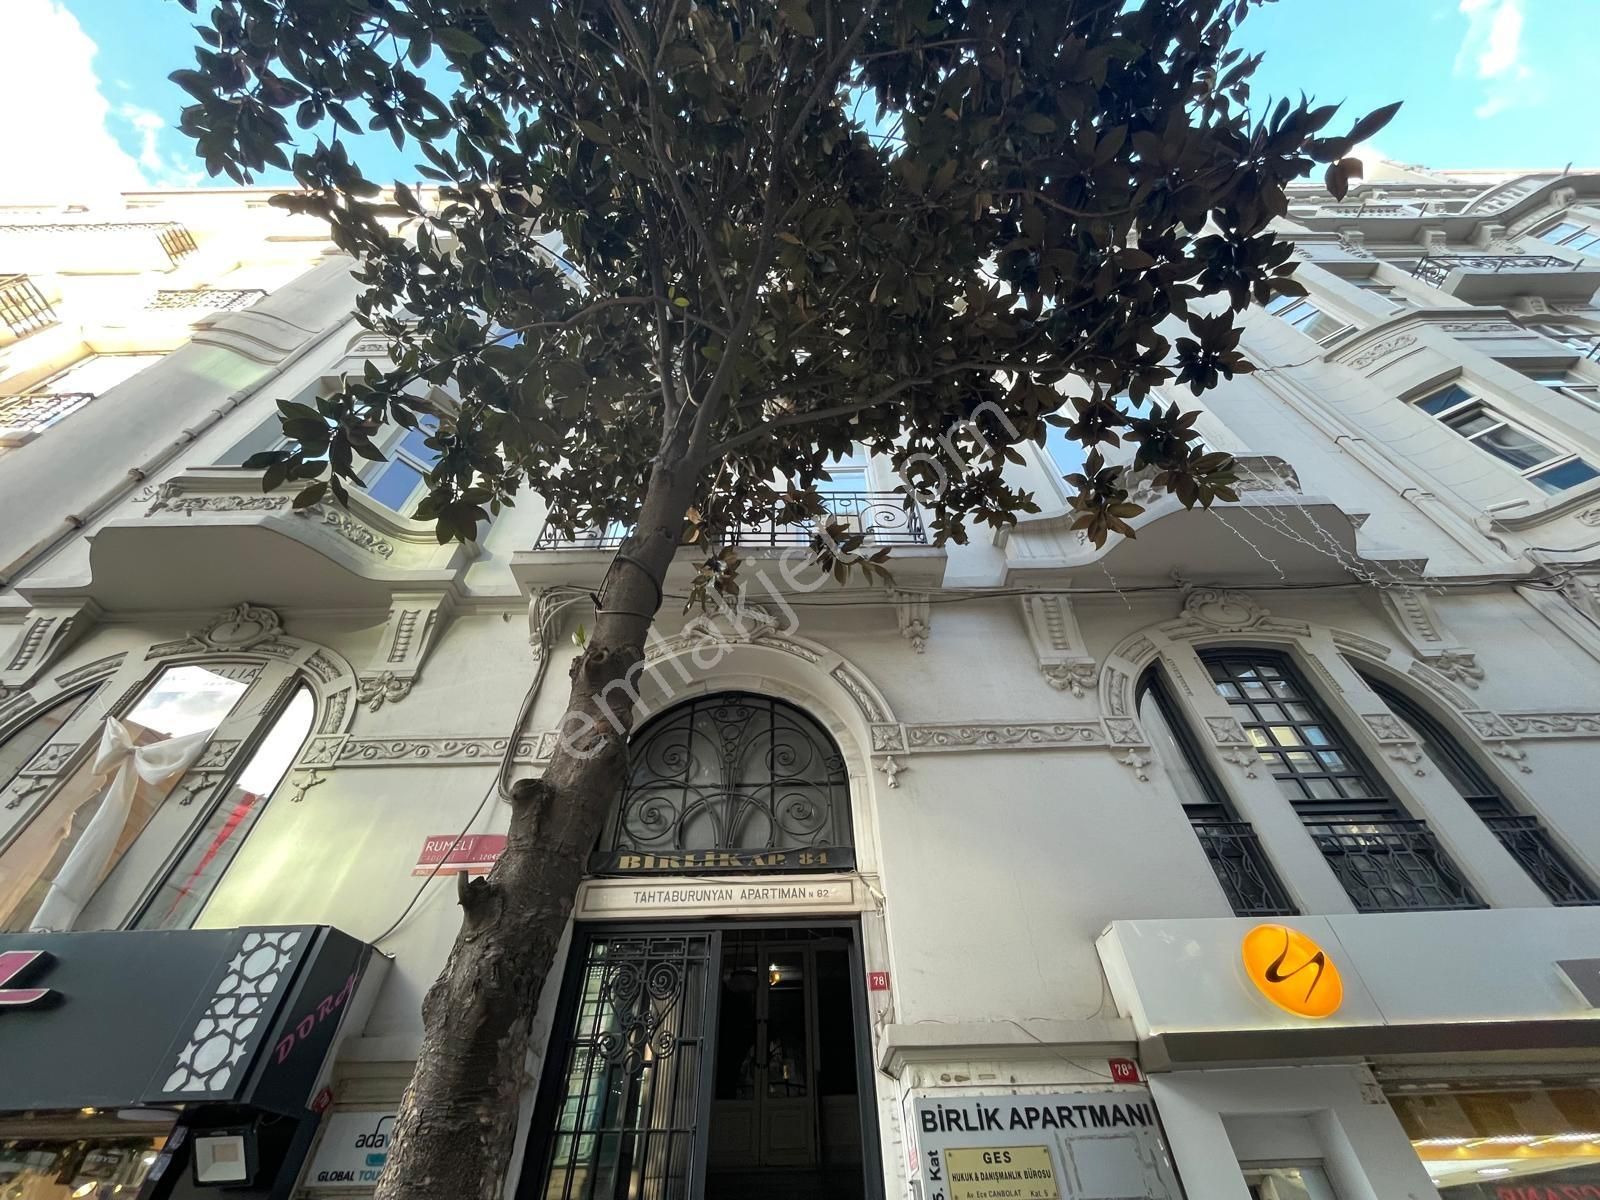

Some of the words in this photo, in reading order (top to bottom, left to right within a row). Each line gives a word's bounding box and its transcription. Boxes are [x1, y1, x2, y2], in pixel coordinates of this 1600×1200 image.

[799, 852, 828, 865] 84
[633, 889, 733, 904] TAHTABURUNYAN
[740, 887, 806, 900] APARTIMAN
[817, 889, 829, 898] 82
[873, 975, 885, 986] 78
[275, 973, 357, 1064] DORA
[921, 1102, 1003, 1133] BİRLİK
[1009, 1103, 1154, 1130] APARTMANI
[927, 1149, 942, 1181] Kat
[983, 1151, 1012, 1164] GES
[318, 1170, 355, 1182] GLOBAL
[359, 1170, 381, 1181] TOU
[952, 1172, 973, 1182] HUKUK
[981, 1170, 1022, 1183] DANIŞMANLIK
[1024, 1168, 1051, 1179] BÜROSU
